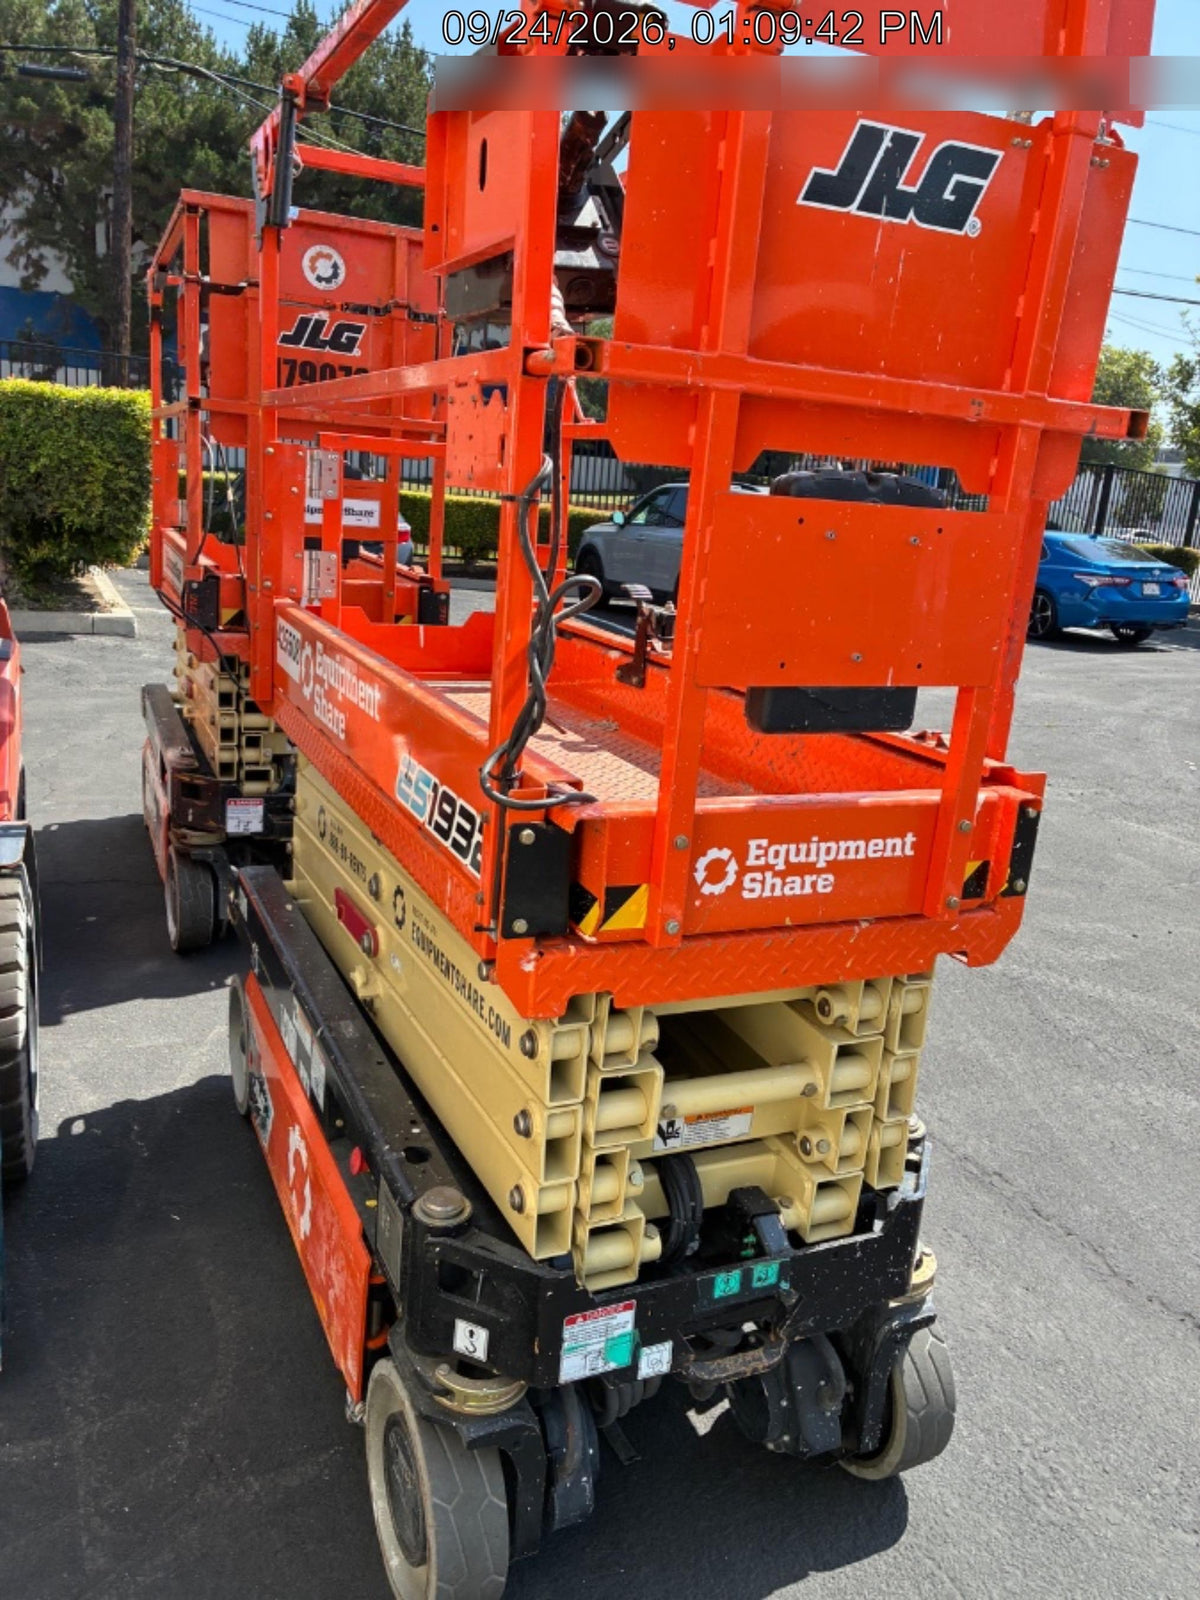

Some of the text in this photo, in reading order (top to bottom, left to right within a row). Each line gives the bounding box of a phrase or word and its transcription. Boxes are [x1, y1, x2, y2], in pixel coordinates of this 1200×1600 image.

[797, 119, 1004, 235] JLG
[278, 315, 367, 355] JLG
[316, 641, 381, 722] Equipment
[314, 684, 345, 740] Share
[746, 832, 916, 870] Equipment
[742, 871, 835, 899] Share
[411, 921, 511, 1049] EQUIPMENTSHARE.COM
